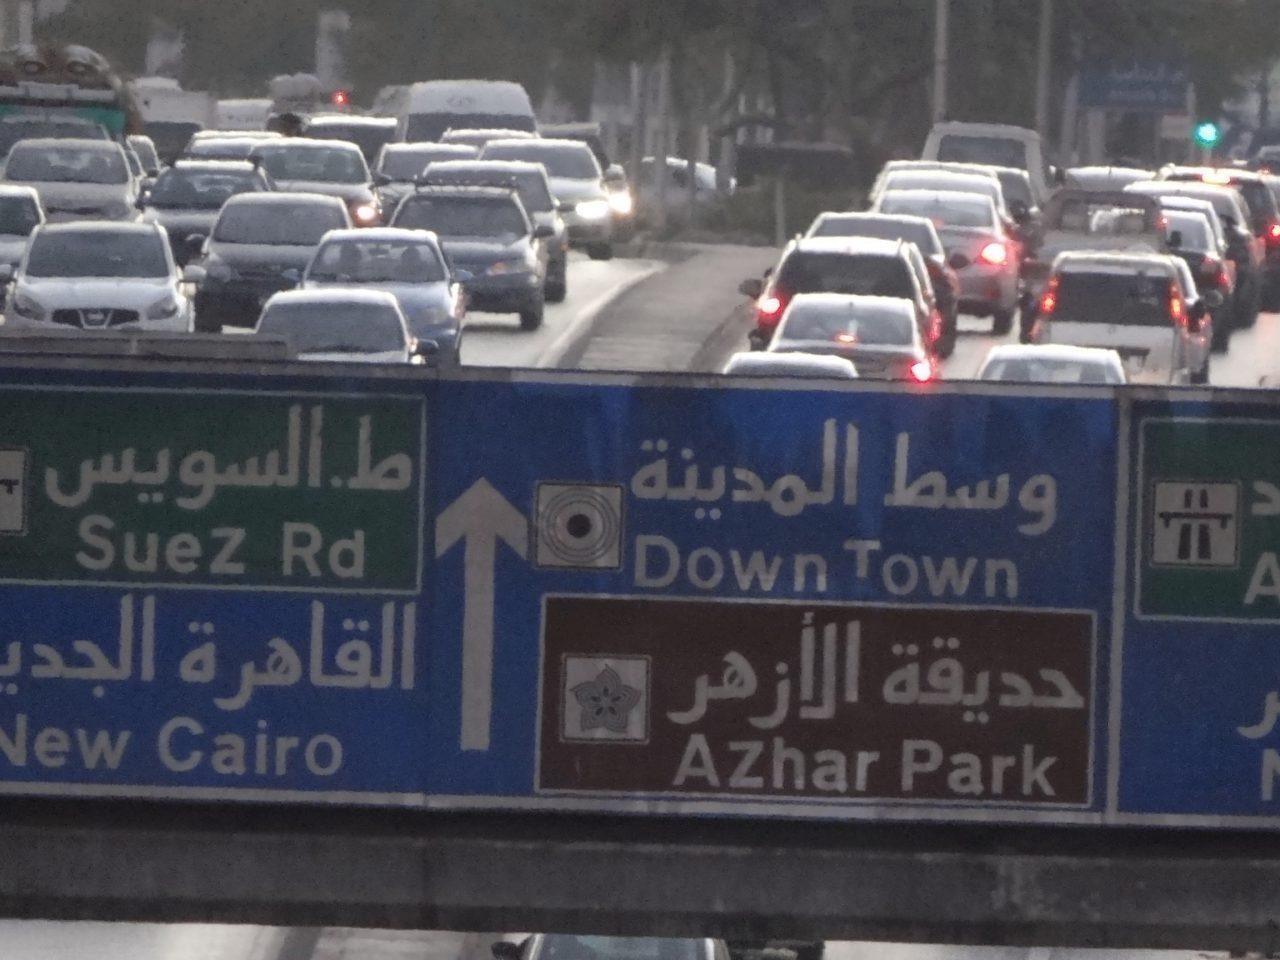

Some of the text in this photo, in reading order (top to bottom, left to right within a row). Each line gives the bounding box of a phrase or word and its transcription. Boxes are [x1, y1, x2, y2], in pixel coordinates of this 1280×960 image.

[630, 417, 1058, 537] وسط المدينة
[74, 515, 366, 579] Suez Rd
[633, 534, 1019, 600] Down Town
[179, 599, 417, 711] القاهرة
[666, 611, 1086, 730] حديقة الأزهر
[156, 716, 344, 776] Cairo
[672, 733, 1060, 798] Azhar Park
